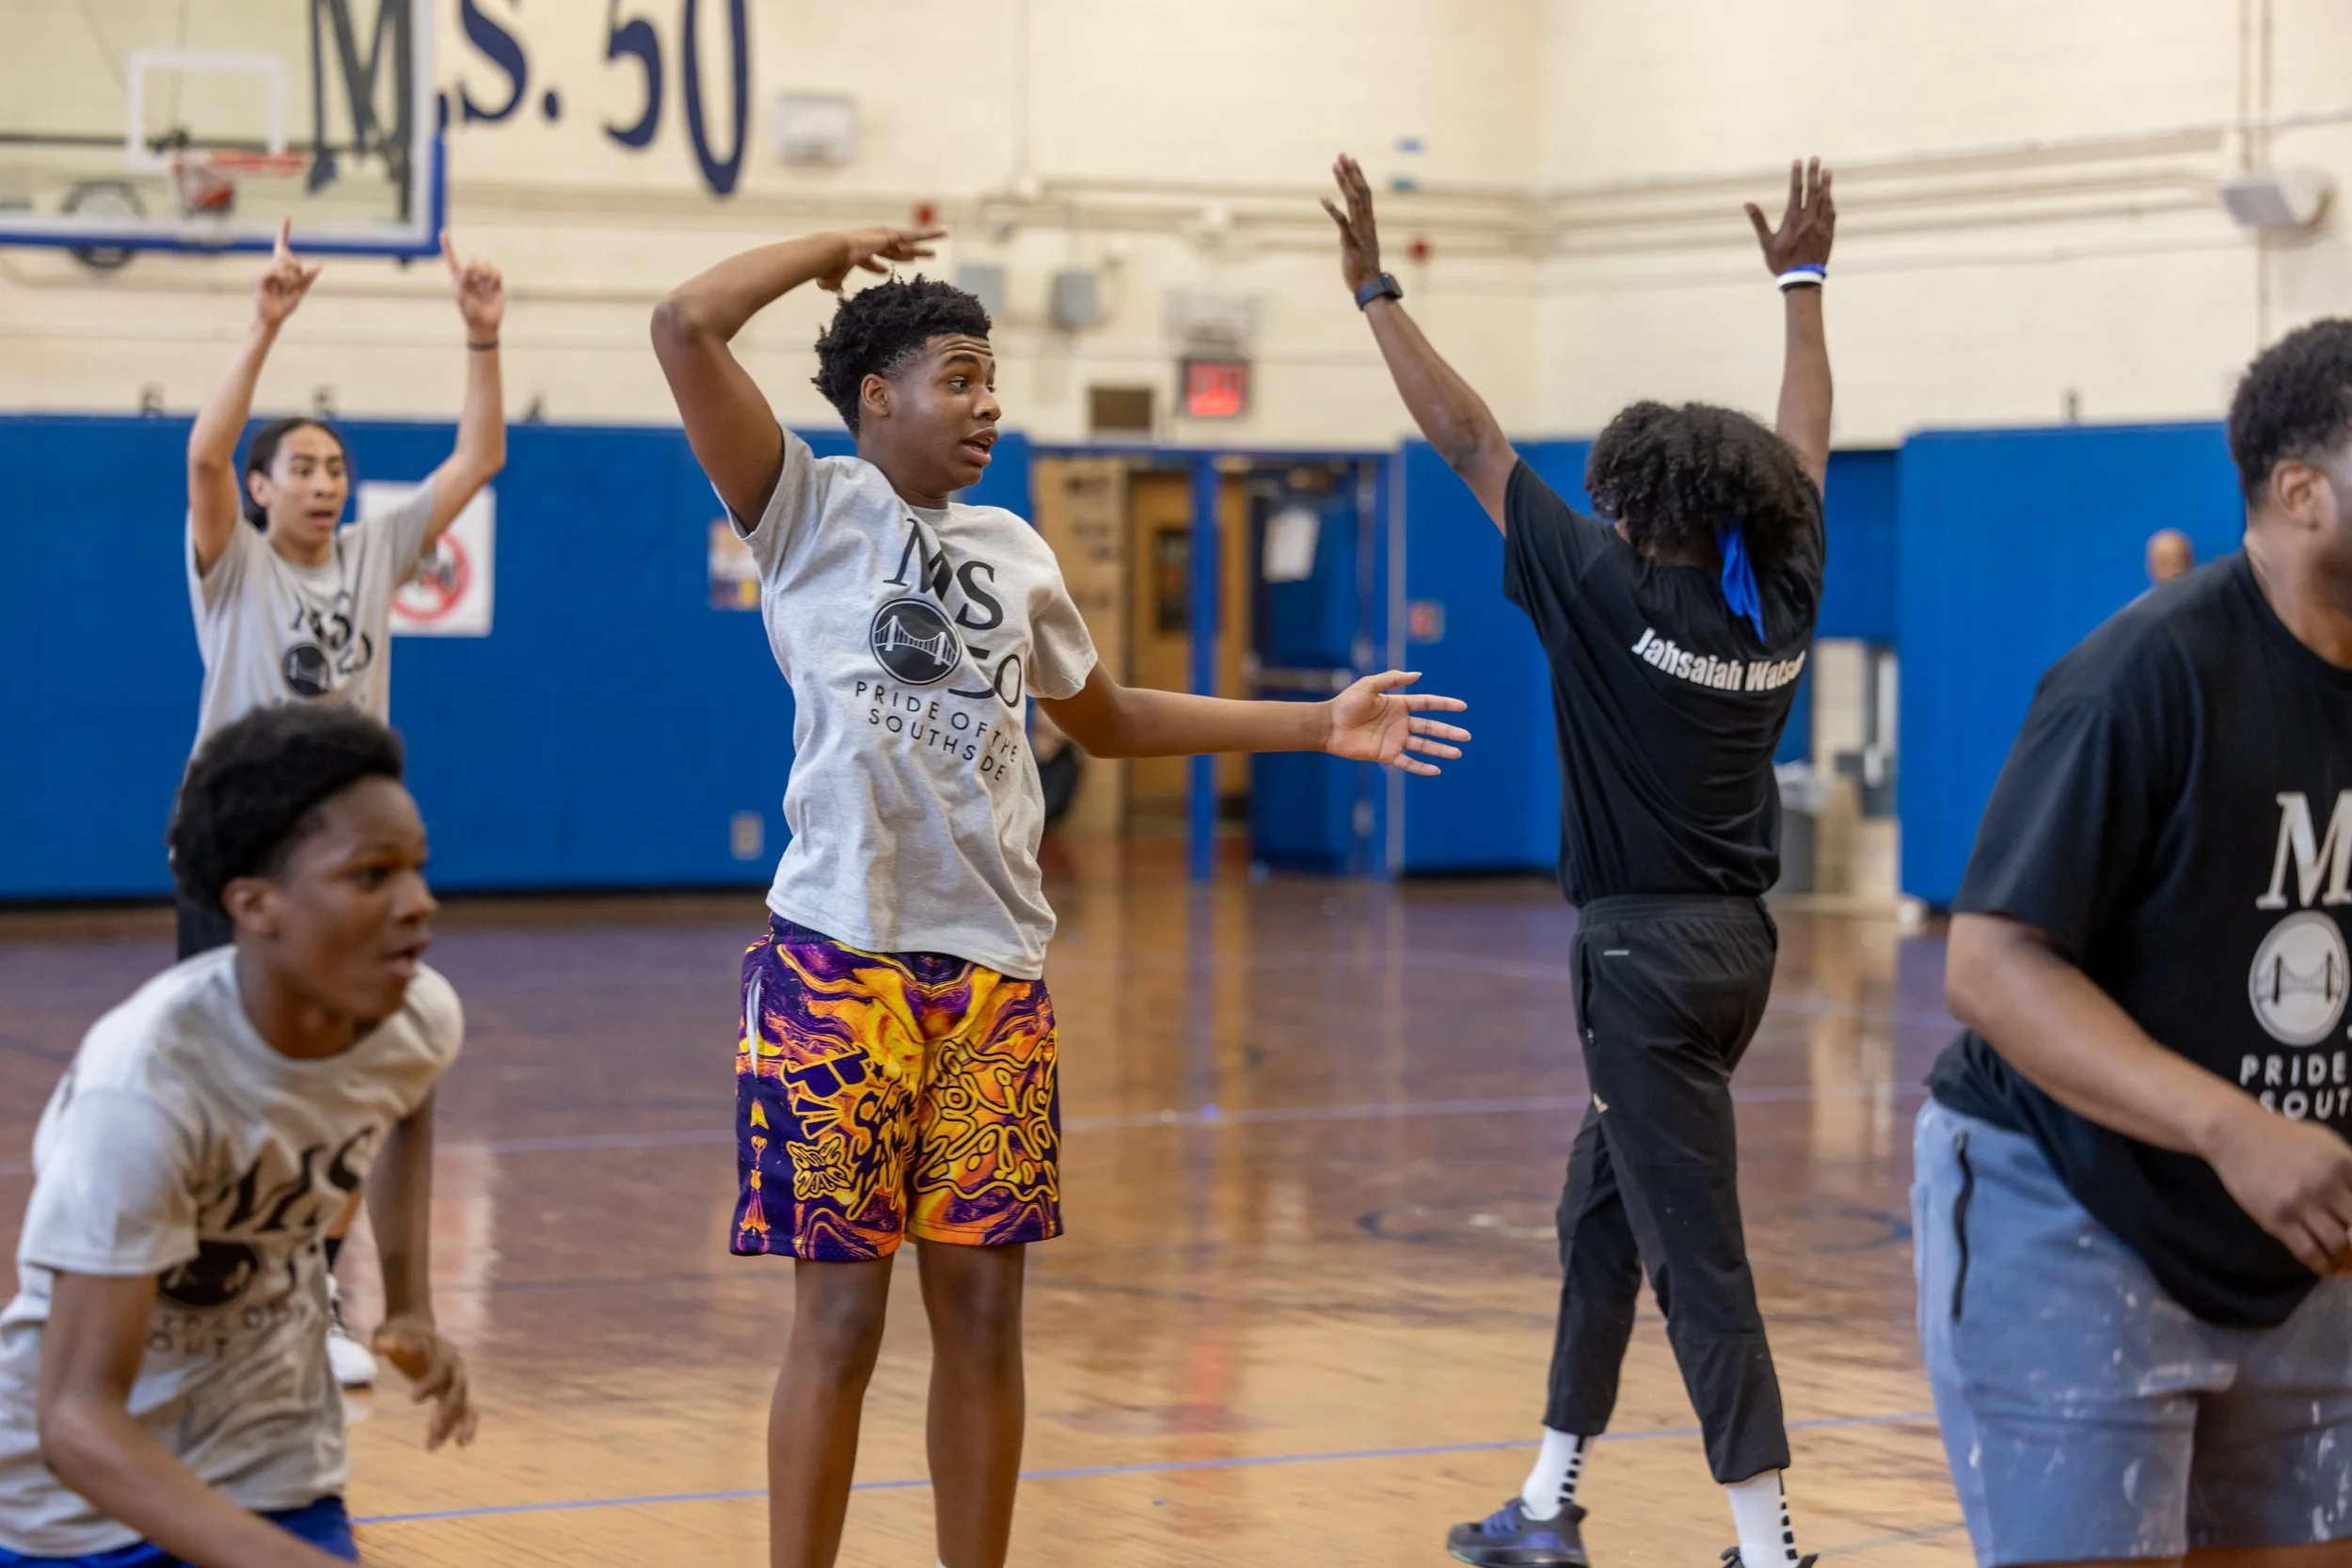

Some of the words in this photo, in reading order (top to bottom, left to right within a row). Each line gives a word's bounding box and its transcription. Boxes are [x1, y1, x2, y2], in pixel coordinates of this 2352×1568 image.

[603, 0, 750, 196] 50
[882, 517, 1004, 630] MS
[1630, 626, 1743, 691] Jahsaiah
[854, 680, 941, 721] PRIDE
[950, 711, 988, 738] OF
[990, 730, 1018, 764] THE
[868, 707, 1007, 782] SOUTHSDE
[2239, 1051, 2346, 1087] PRIDE
